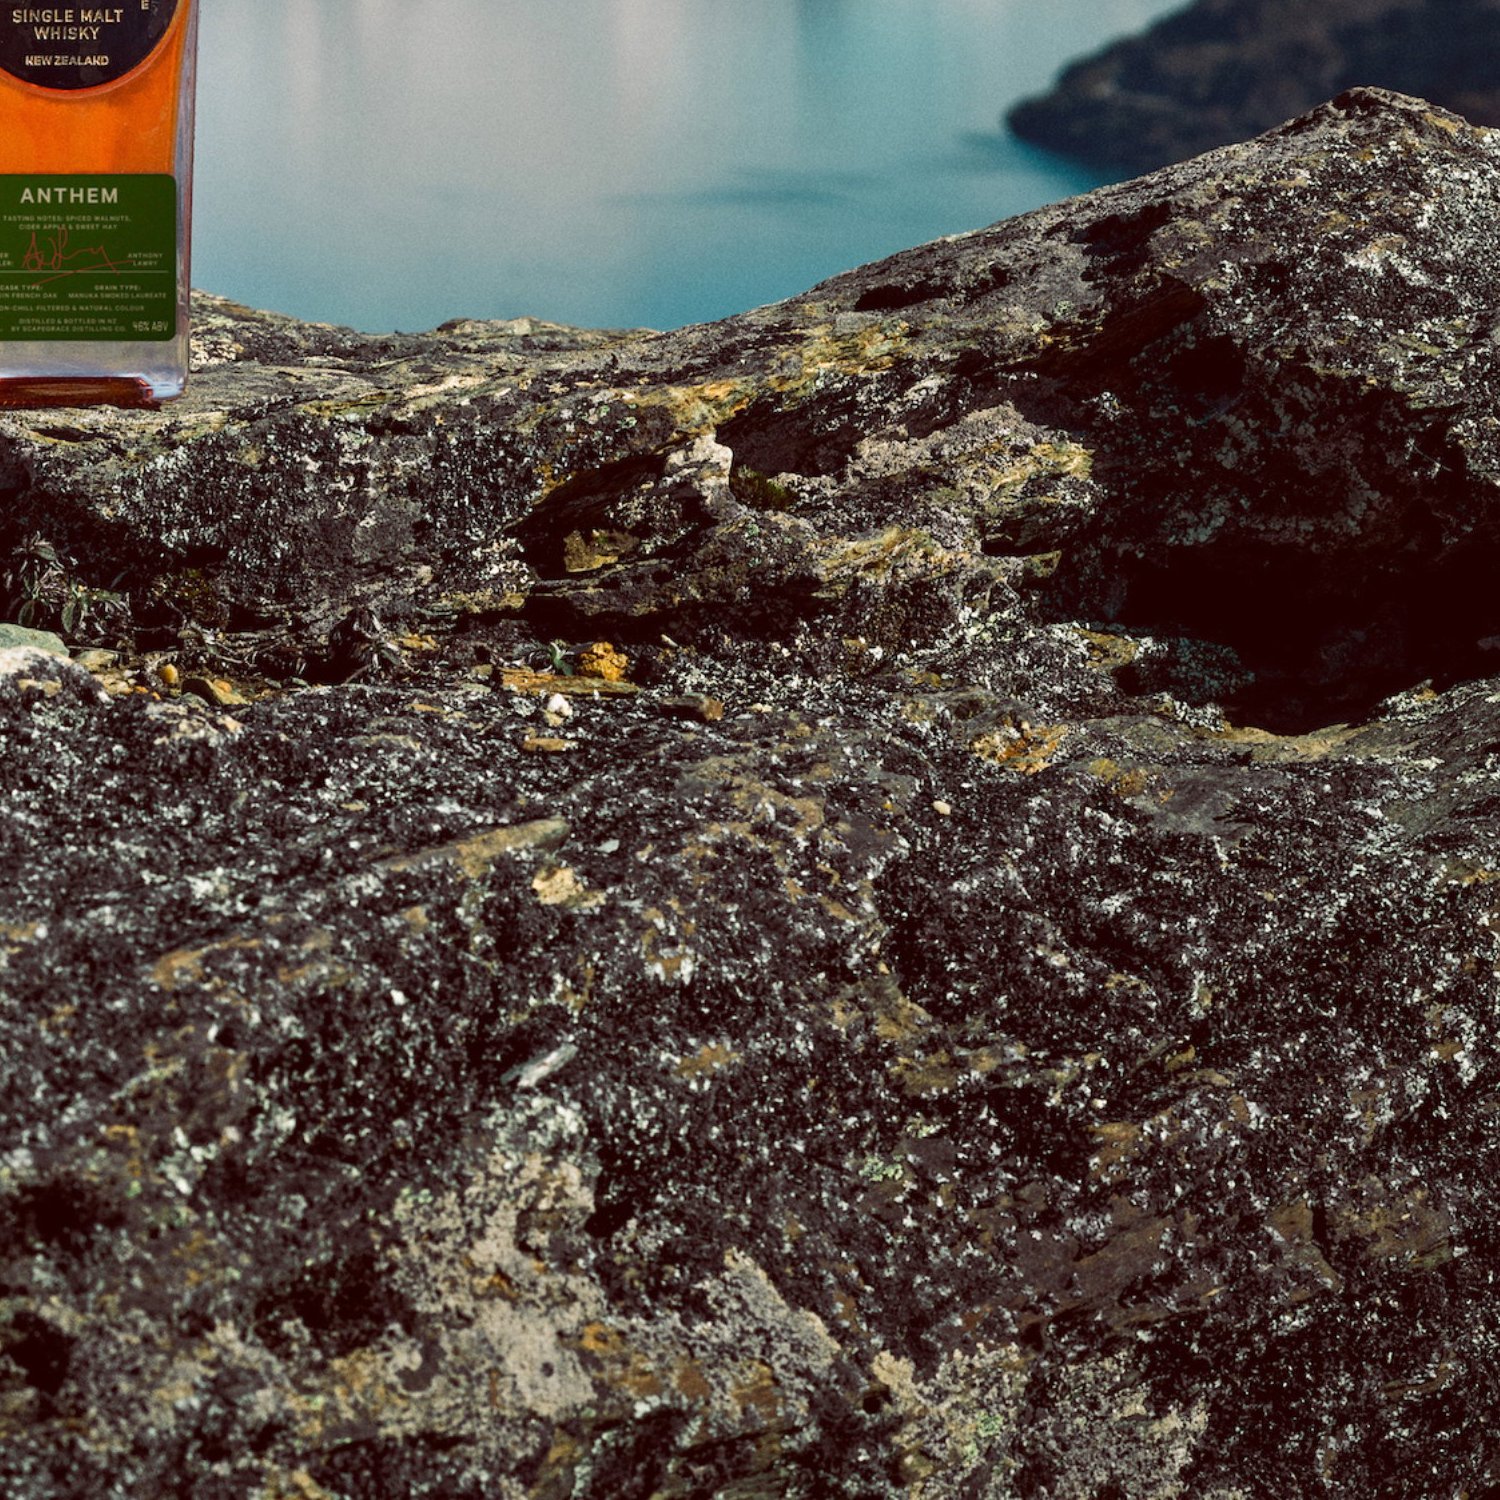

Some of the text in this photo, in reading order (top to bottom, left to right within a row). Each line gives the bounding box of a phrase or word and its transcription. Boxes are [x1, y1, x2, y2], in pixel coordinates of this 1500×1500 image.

[141, 0, 149, 10] E
[12, 9, 124, 23] SINGLE MALT
[33, 26, 100, 40] WHISKY
[25, 55, 109, 66] NEW ZEALAND
[20, 187, 118, 204] ANTHEM
[132, 321, 169, 332] 46% ABV
